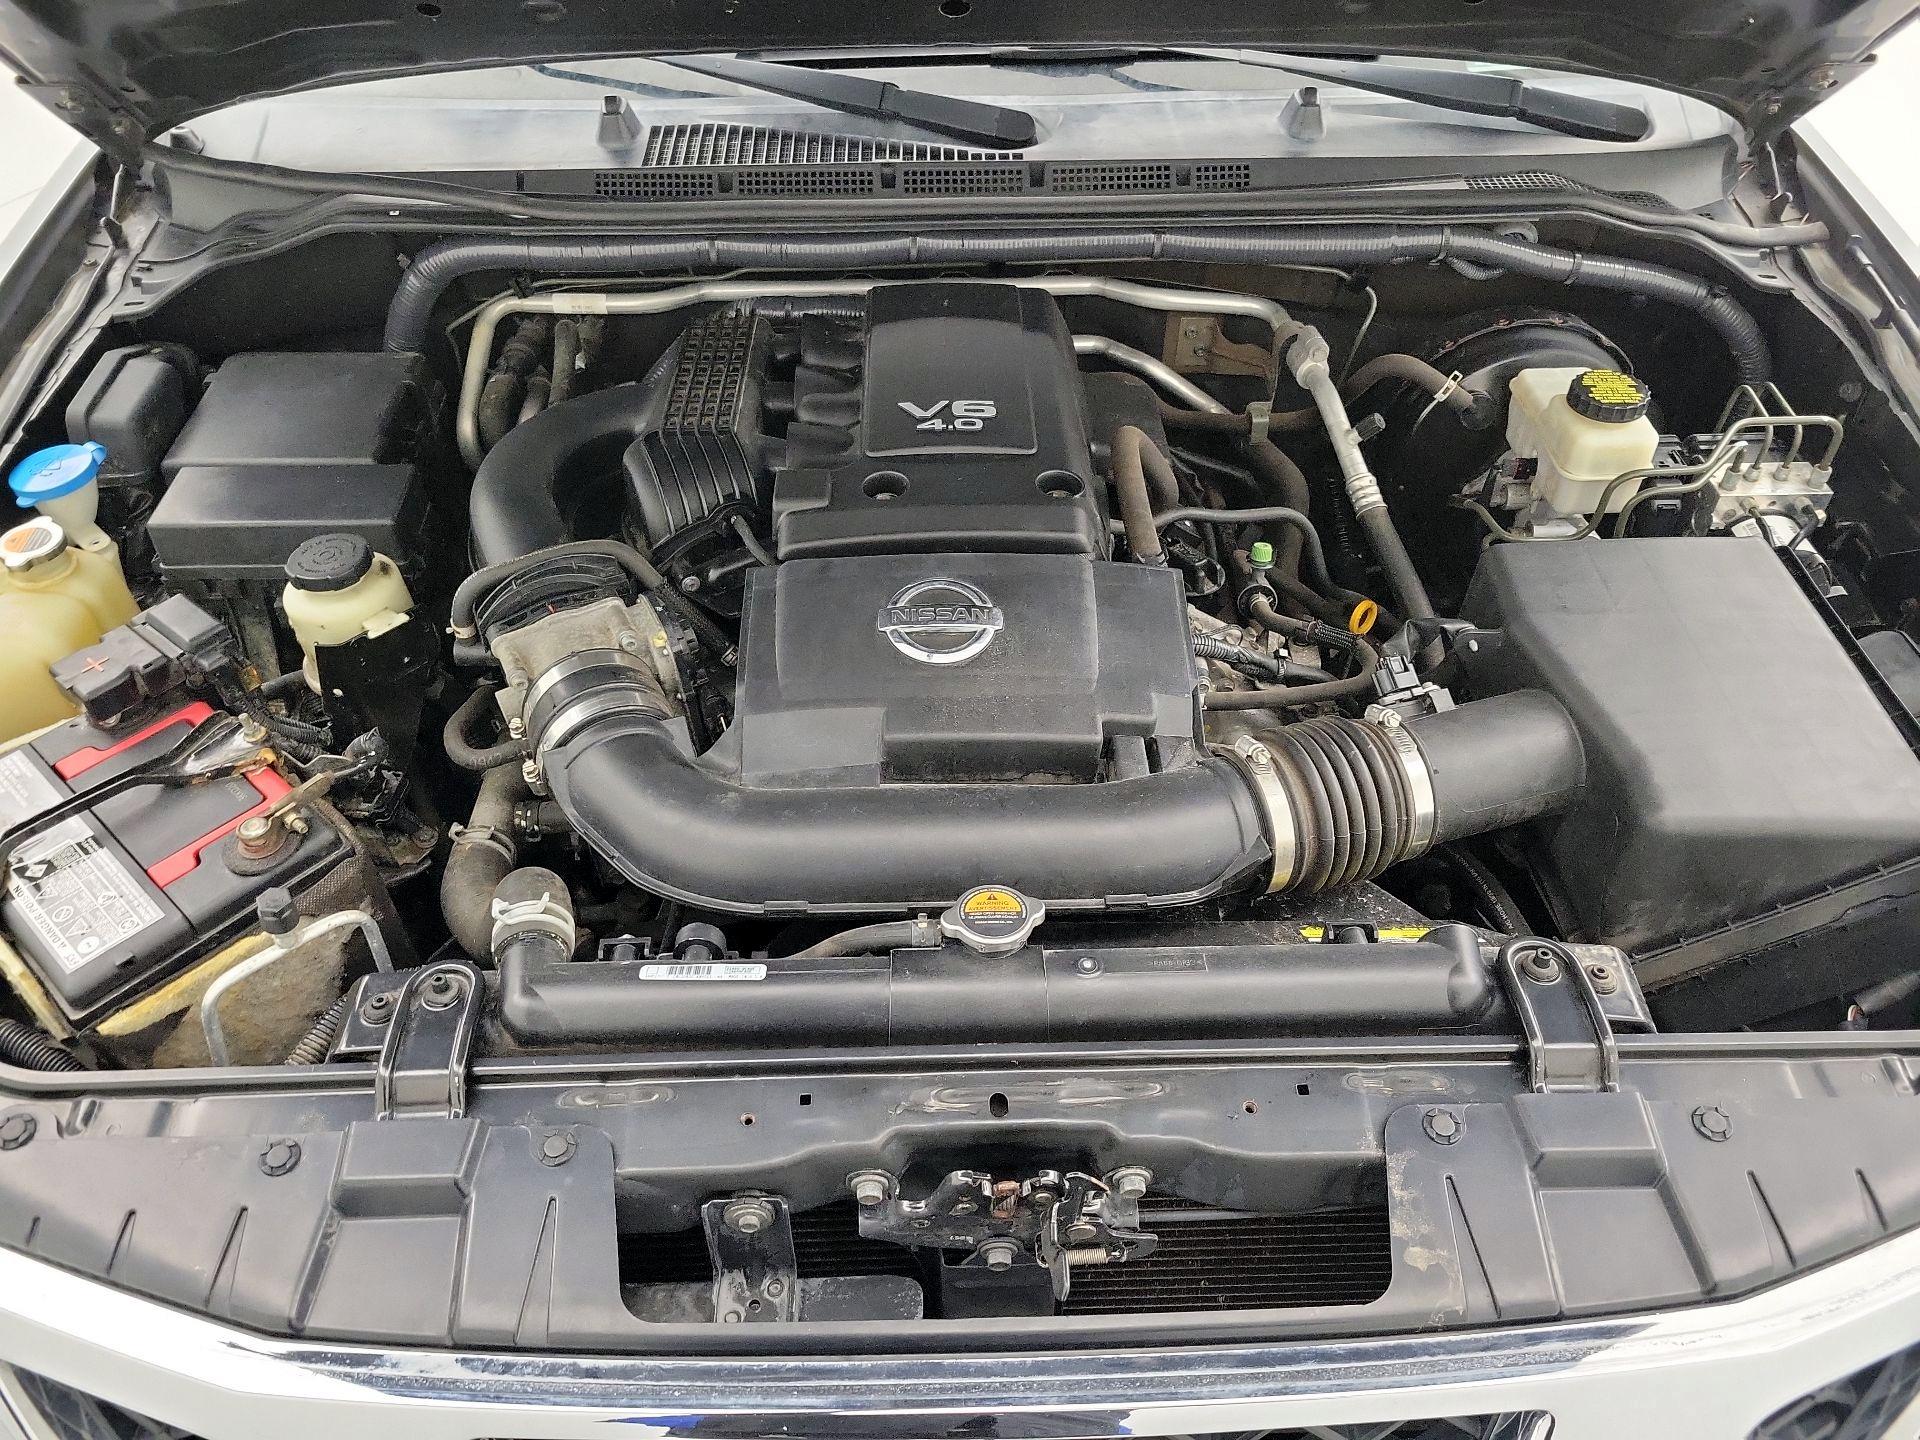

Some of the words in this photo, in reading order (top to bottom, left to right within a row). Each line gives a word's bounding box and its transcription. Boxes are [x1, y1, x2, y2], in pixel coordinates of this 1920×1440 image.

[897, 400, 997, 419] V6
[916, 418, 984, 430] 4.0
[891, 606, 990, 623] NISSAN
